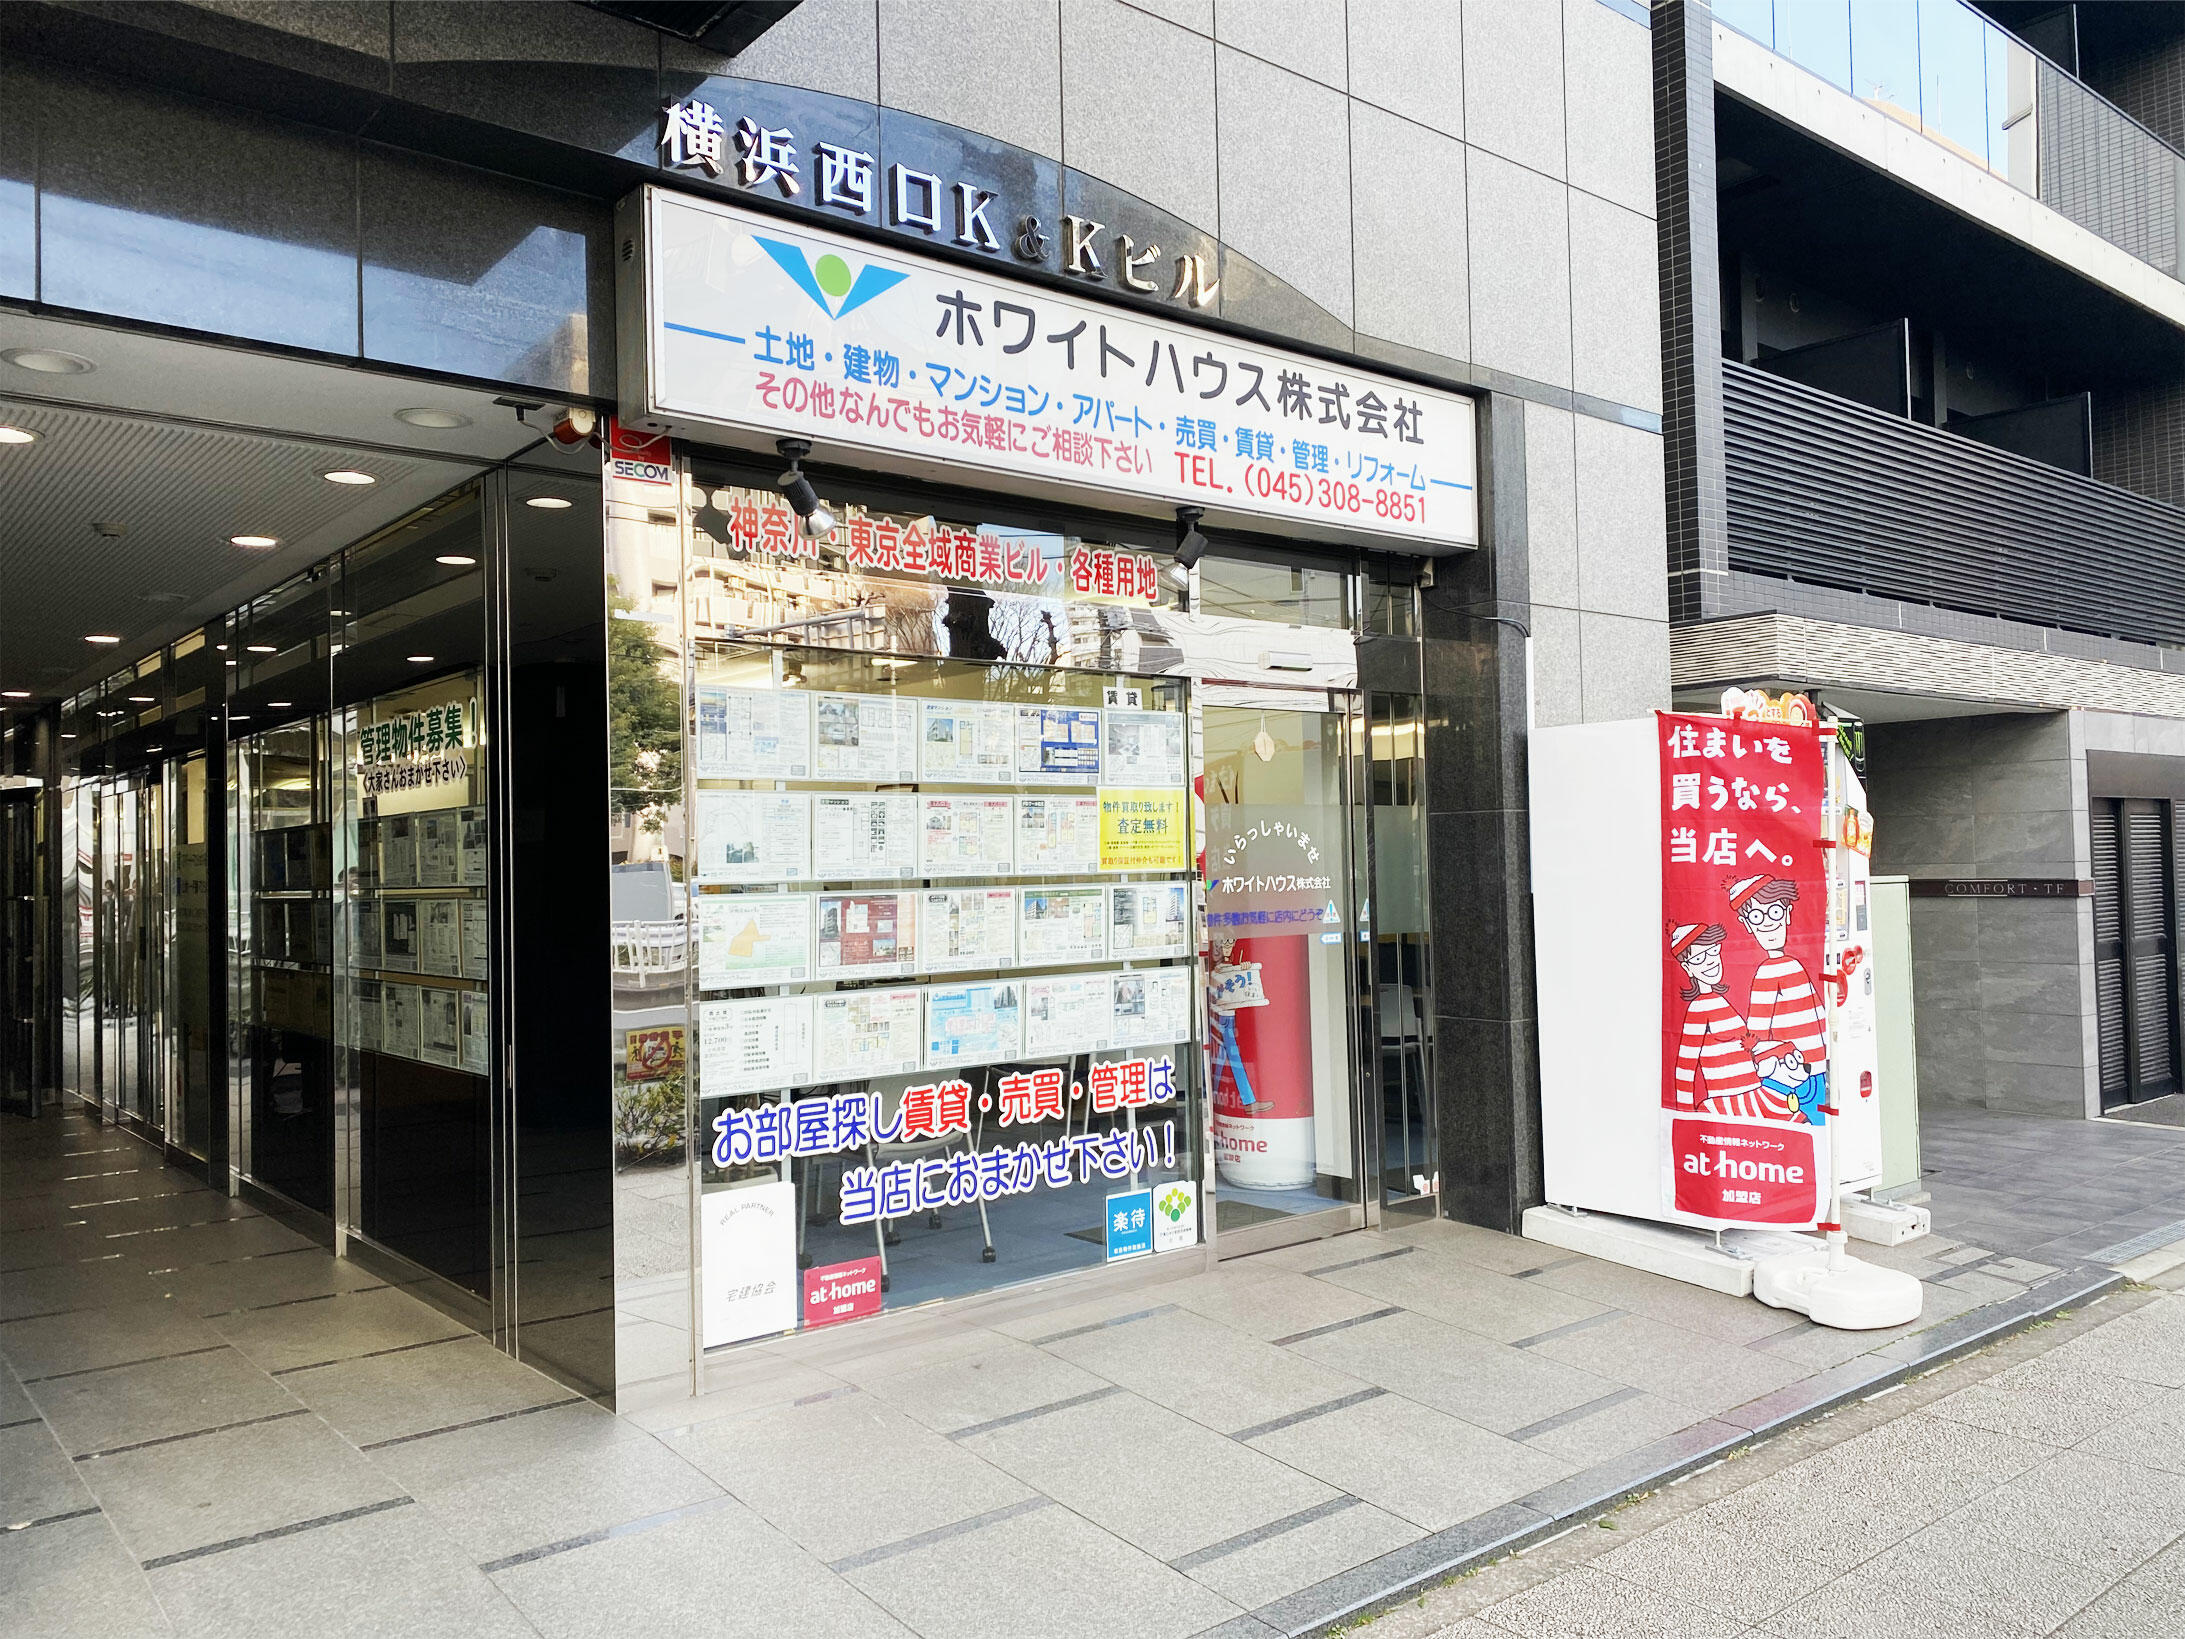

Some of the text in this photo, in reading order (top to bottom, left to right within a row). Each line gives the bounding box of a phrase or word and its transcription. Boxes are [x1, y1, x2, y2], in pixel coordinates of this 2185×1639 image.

[936, 289, 1425, 445] ホワイトハウス株式会社
[754, 370, 1153, 475] その他なんでもお気軽にご相談下さい
[614, 460, 669, 481] SECOM
[360, 700, 477, 766] 管理物件募集！
[1667, 724, 1793, 765] 住まいを
[1671, 772, 1802, 814] 買うなら、
[1117, 817, 1169, 835] 査定無料
[1223, 819, 1321, 866] いらっしゃいませ
[1670, 826, 1794, 867] 当店へ。
[1222, 874, 1332, 894] ホワイトハウス株式会社
[1944, 882, 2065, 895] COMFORT TF
[713, 1056, 1175, 1166] お部屋探し賃貸・売買・管理は
[1699, 1133, 1785, 1152] 不動産情報ネットワーク
[839, 1121, 1177, 1226] 当店におまかせ下さい！
[740, 1201, 776, 1217] PARTNER
[1721, 1188, 1762, 1205] 加盟店
[1113, 1208, 1146, 1232] 楽待
[727, 1280, 777, 1303] 宅建協会
